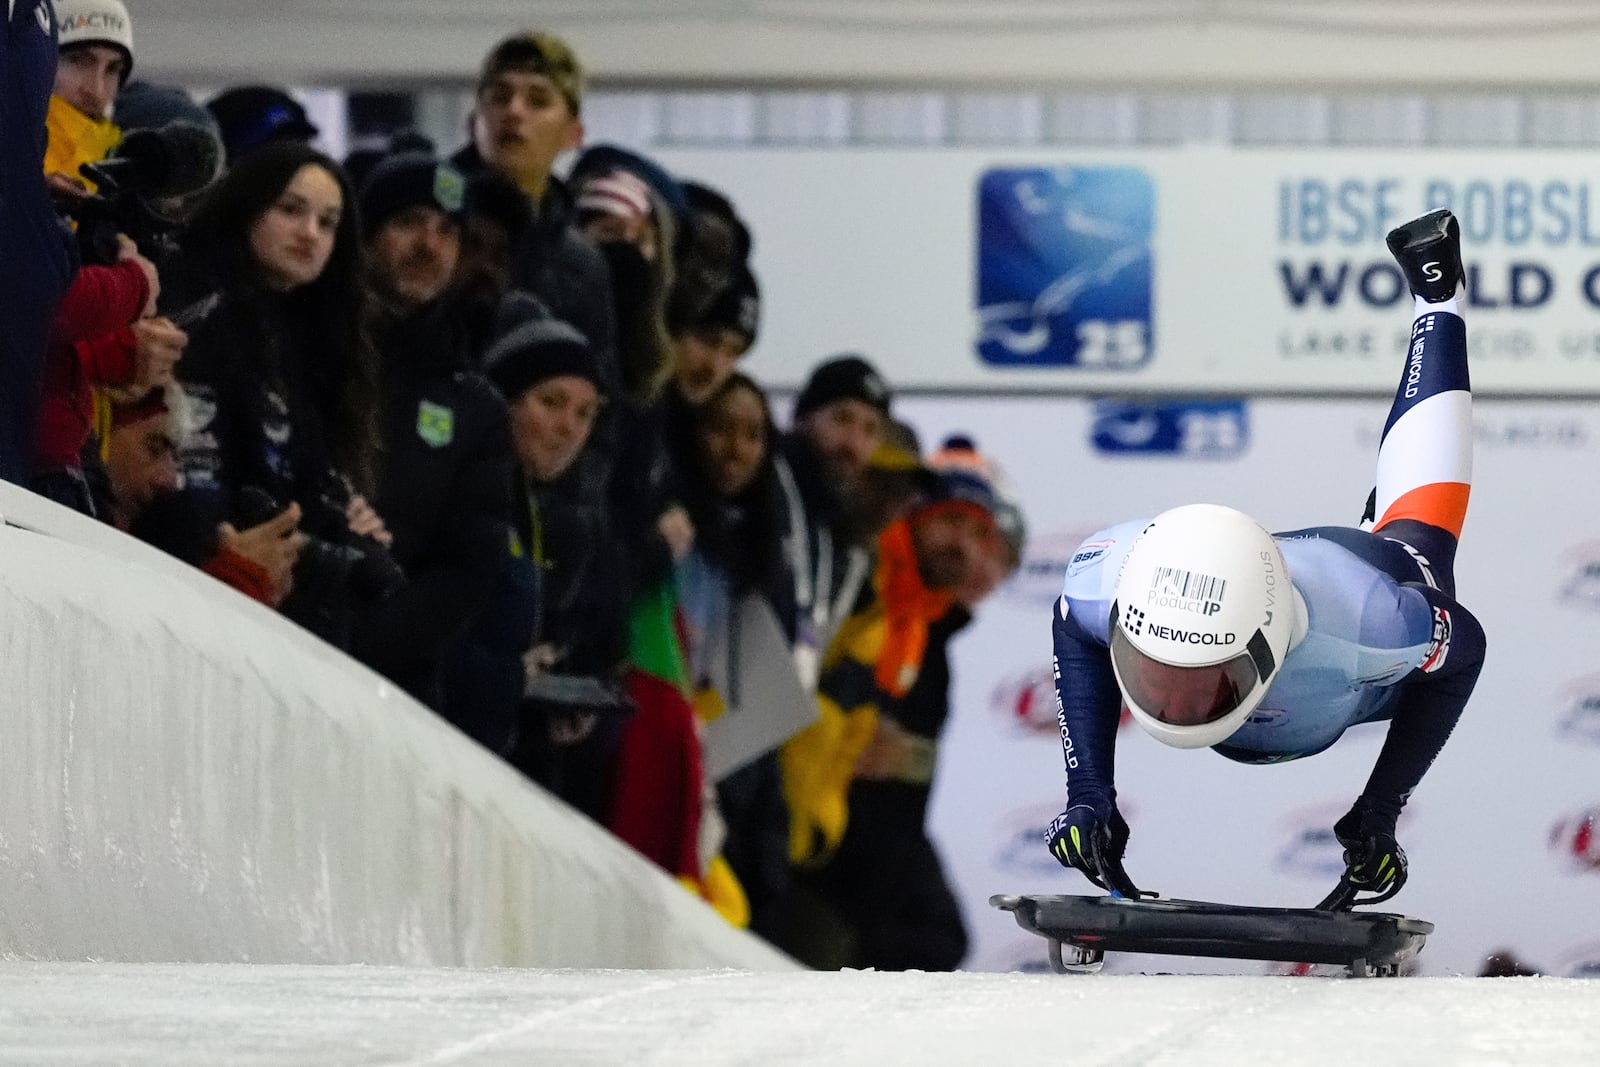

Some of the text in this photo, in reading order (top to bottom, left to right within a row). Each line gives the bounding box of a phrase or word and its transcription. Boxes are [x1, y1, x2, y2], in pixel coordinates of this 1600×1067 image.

[1278, 177, 1397, 244] IBSF
[1279, 261, 1553, 310] WOLD
[1405, 337, 1425, 399] NEWCOLD
[1148, 623, 1236, 645] NEWCOLD
[1055, 688, 1079, 769] NEWCOLD
